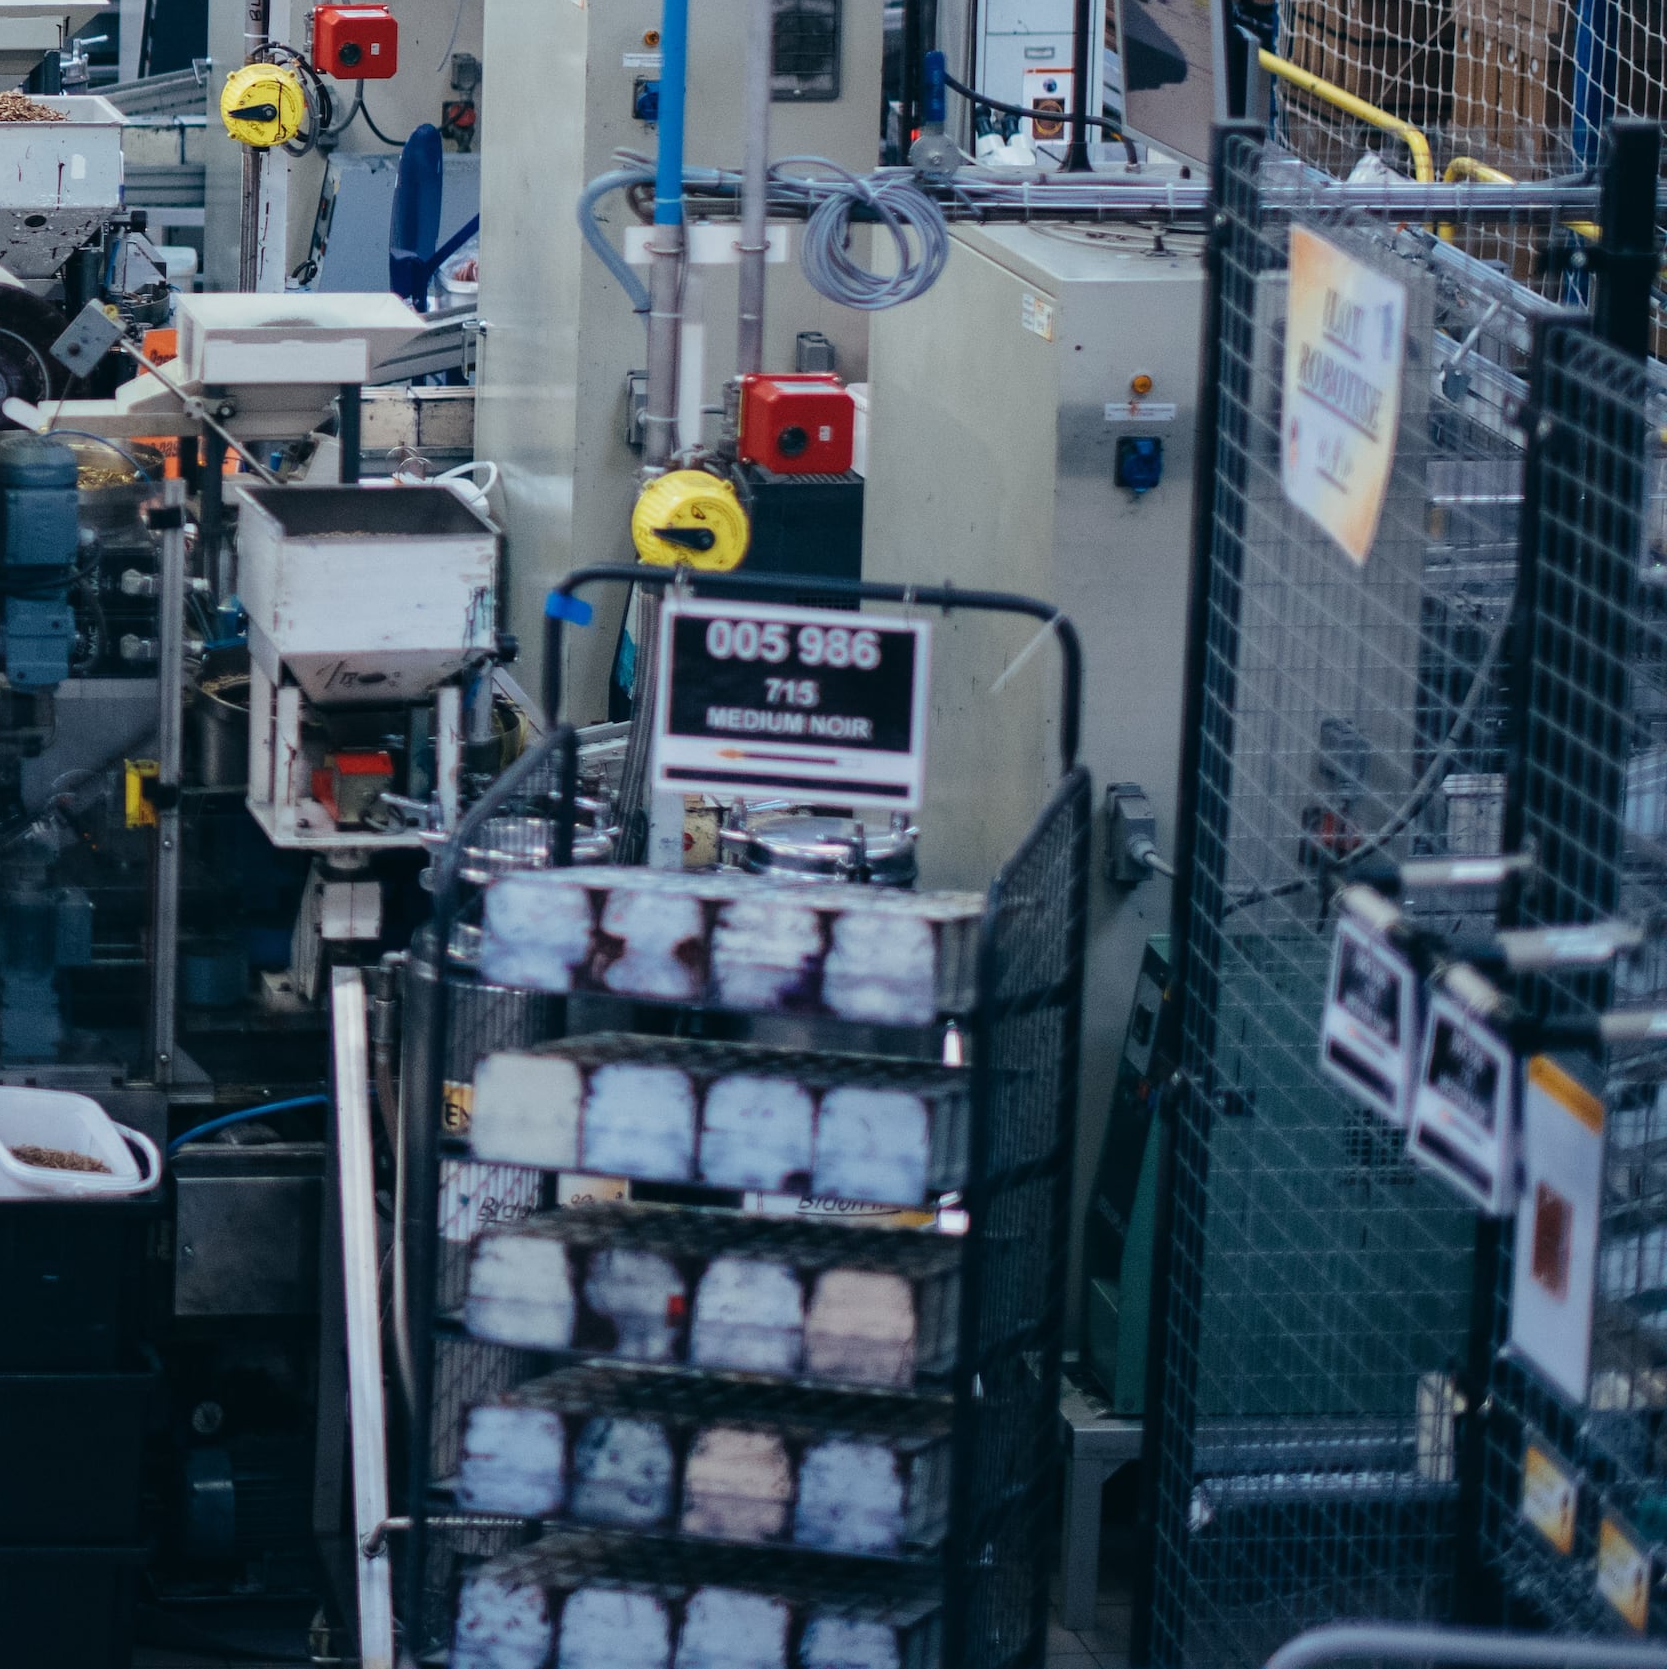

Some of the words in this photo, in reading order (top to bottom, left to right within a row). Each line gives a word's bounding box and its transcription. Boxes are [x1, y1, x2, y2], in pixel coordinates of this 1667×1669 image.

[705, 619, 791, 664] 005
[797, 626, 881, 671] 986
[764, 677, 820, 709] 715
[705, 705, 803, 734] MEDIUM
[809, 713, 874, 741] NOIR
